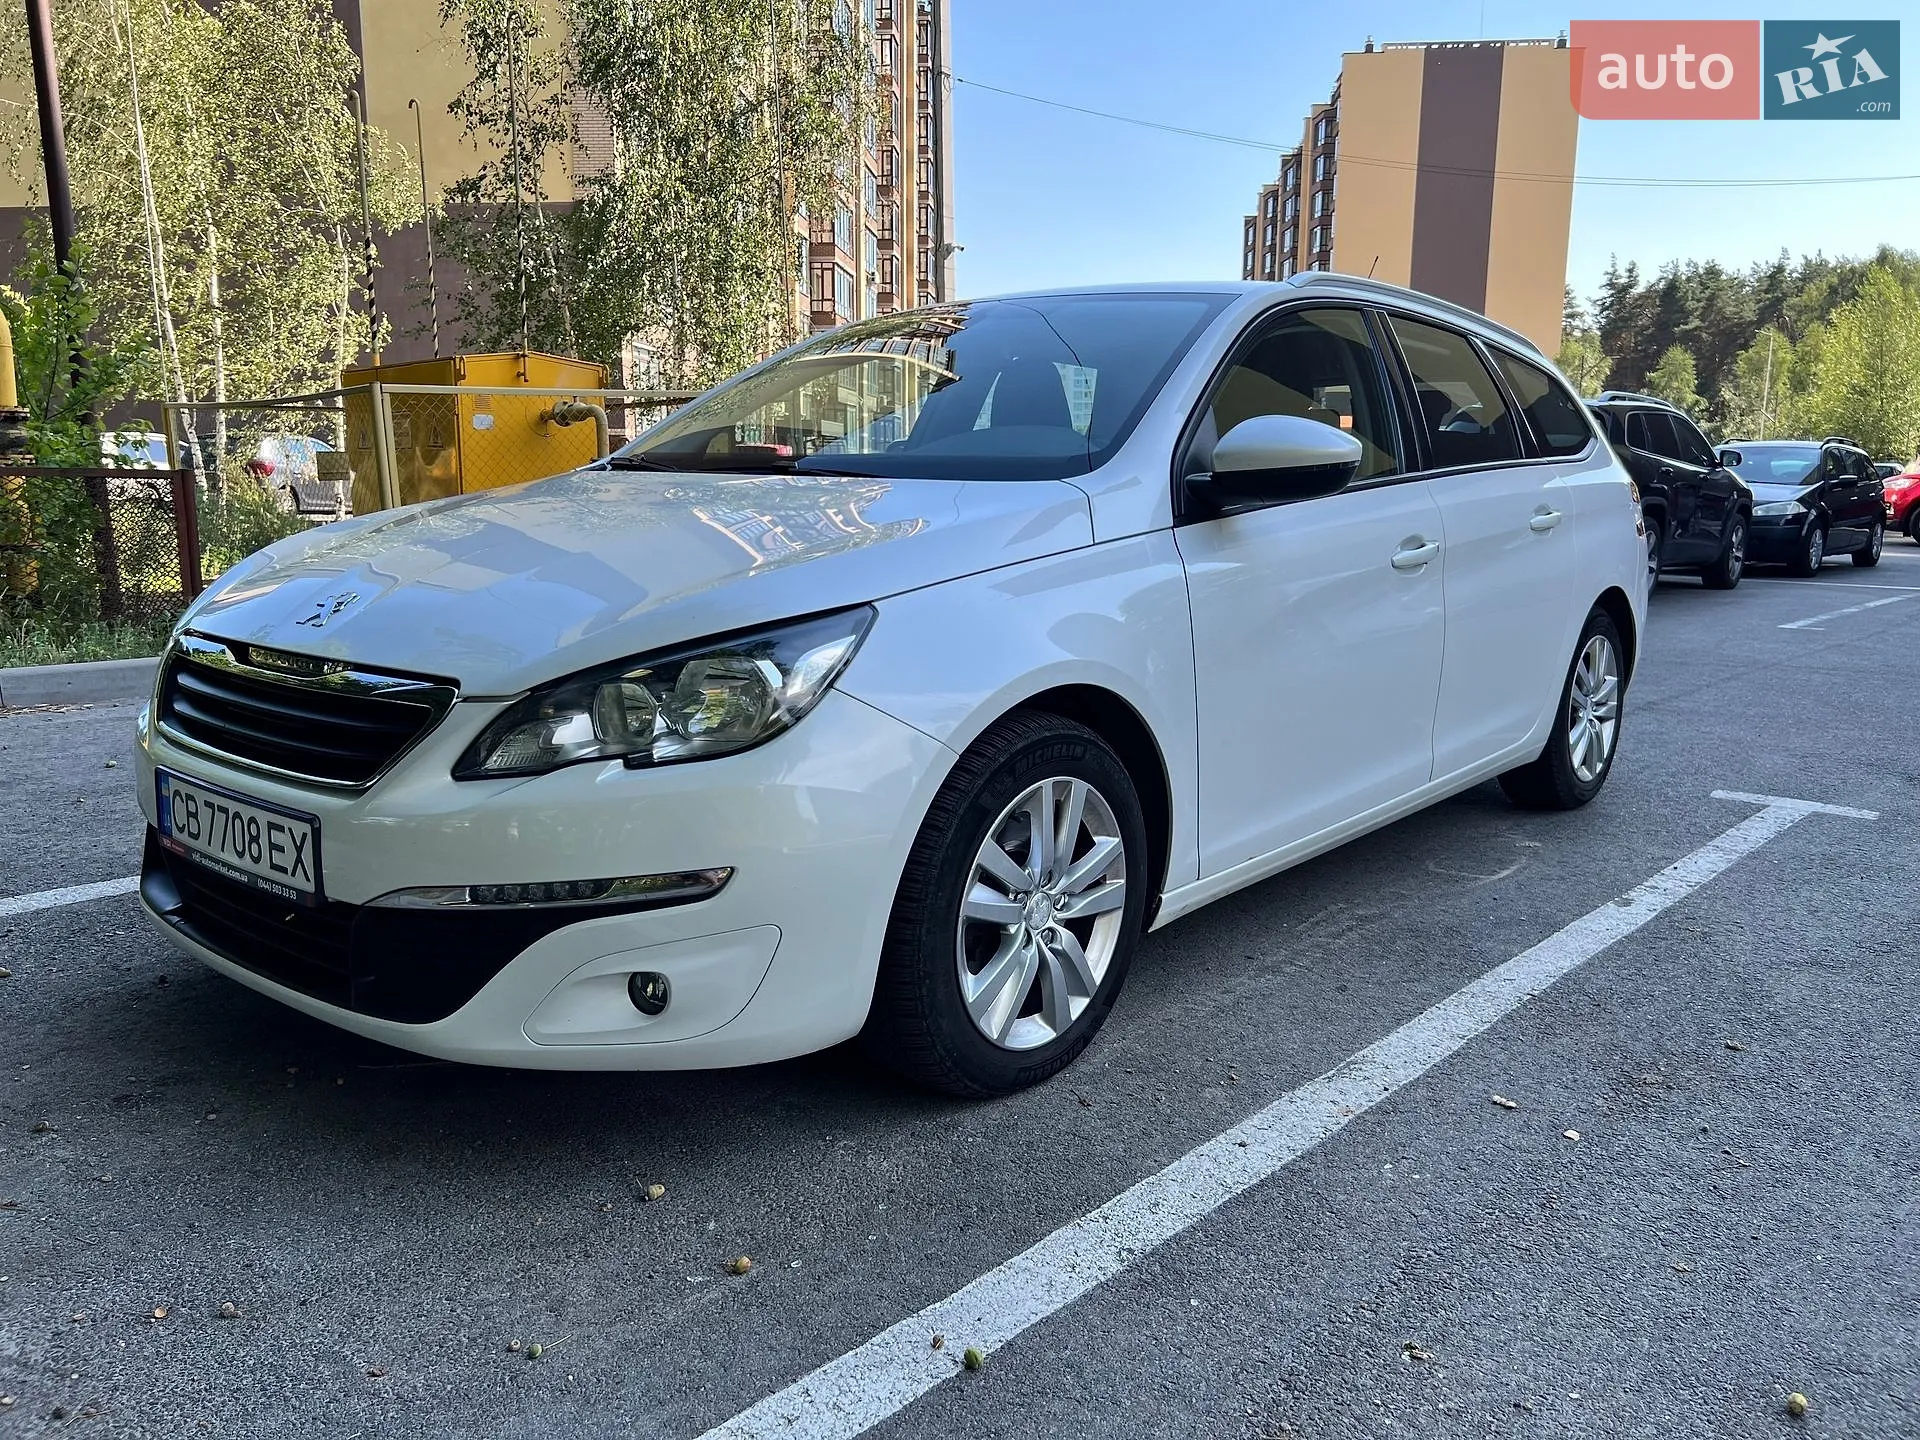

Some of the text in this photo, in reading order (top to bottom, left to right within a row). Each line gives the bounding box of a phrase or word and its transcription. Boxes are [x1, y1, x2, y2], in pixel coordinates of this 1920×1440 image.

[172, 789, 311, 883] CB 7708 EX
[257, 878, 272, 892] (044)
[272, 883, 282, 895] 503
[282, 887, 290, 898] 33
[290, 890, 297, 900] 53
